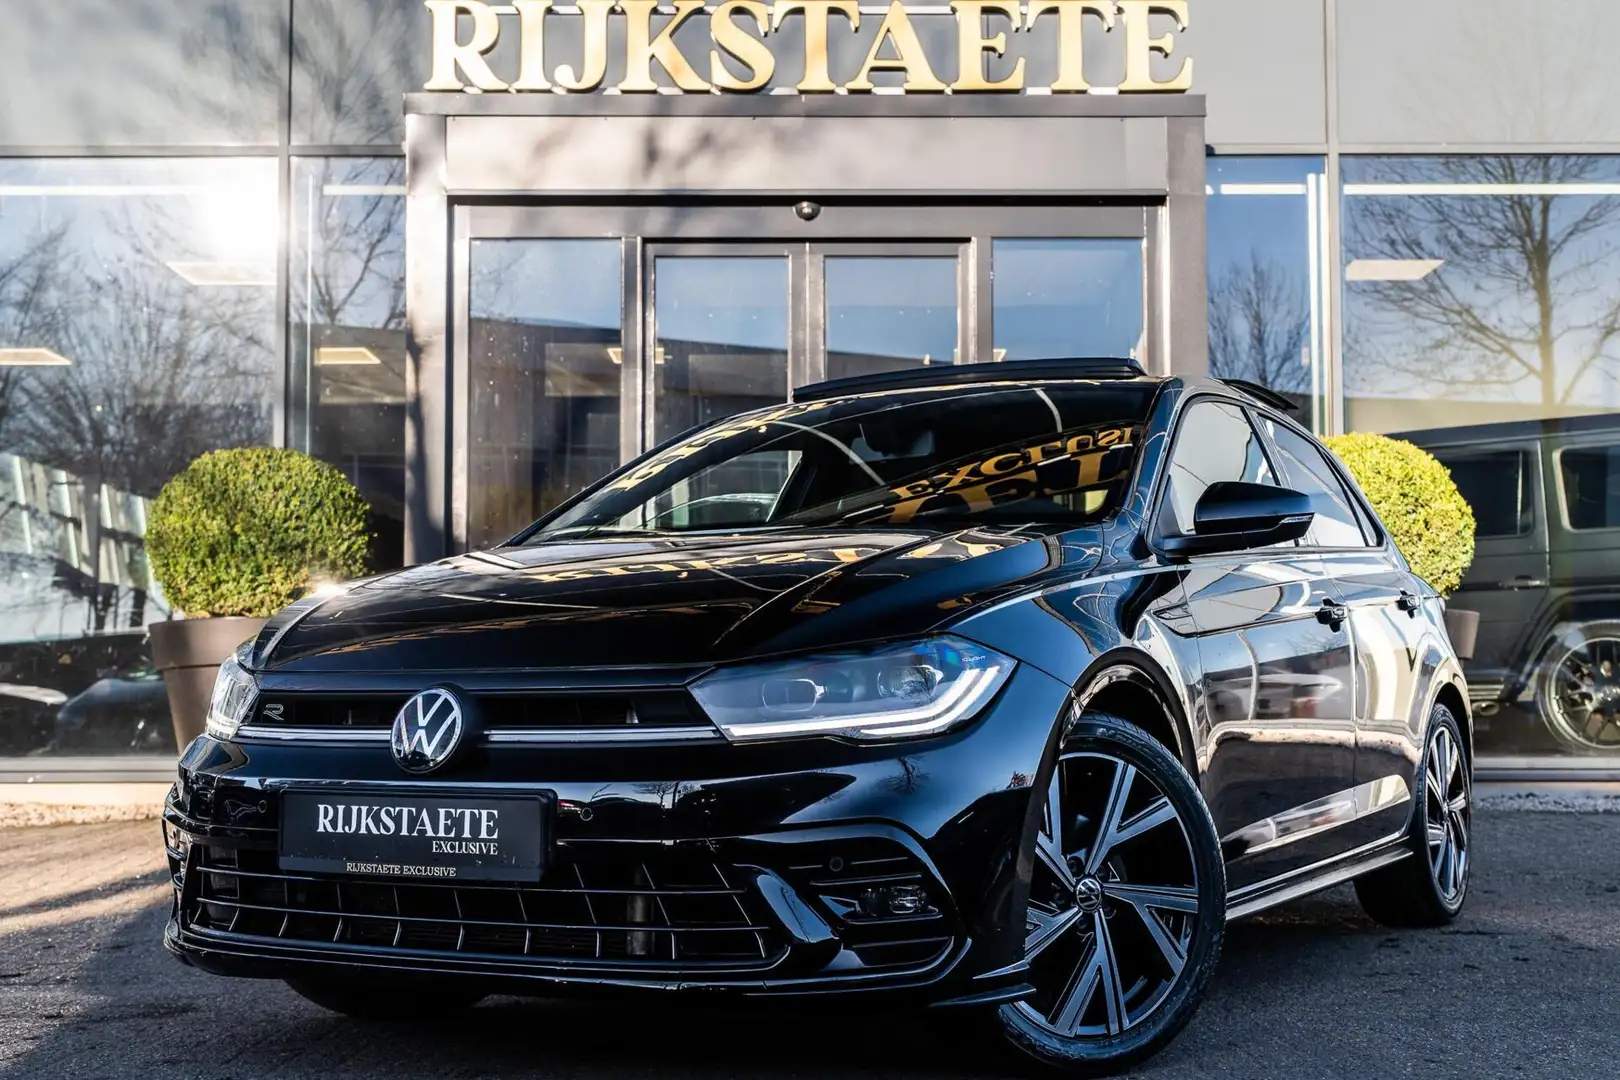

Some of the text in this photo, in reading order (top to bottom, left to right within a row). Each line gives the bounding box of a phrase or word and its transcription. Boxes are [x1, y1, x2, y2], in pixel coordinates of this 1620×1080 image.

[424, 0, 1194, 94] RIJKSTAETE
[316, 804, 499, 839] RIJKSTAETE
[432, 841, 499, 856] EXCLUSIVE
[346, 862, 457, 877] RIJKSTAETE EXCLUSIVE
